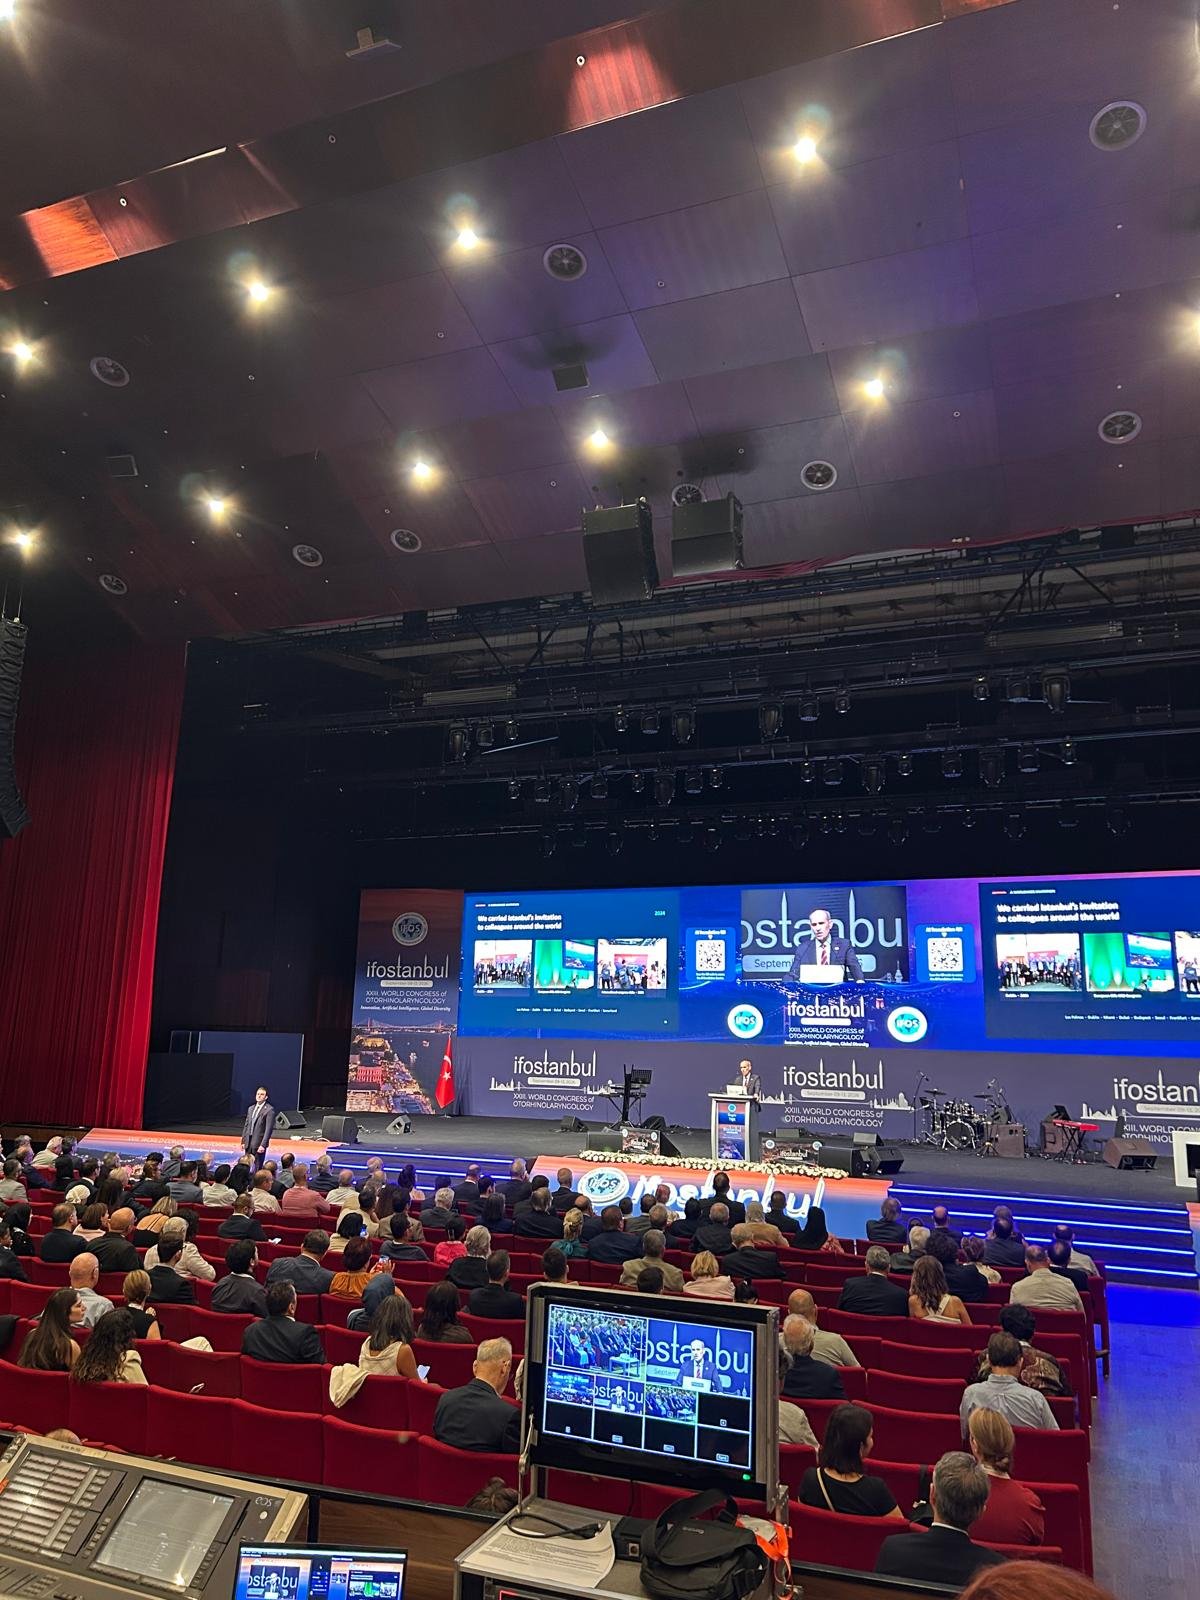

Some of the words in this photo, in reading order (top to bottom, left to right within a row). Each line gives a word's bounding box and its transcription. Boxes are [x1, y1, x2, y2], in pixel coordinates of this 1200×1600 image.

[996, 904, 1011, 912] We
[1012, 903, 1039, 912] carried
[997, 914, 1007, 923] to
[1007, 914, 1049, 923] colleagues
[1050, 913, 1079, 922] around
[1080, 912, 1094, 921] the
[1094, 912, 1120, 921] world
[366, 953, 449, 978] ifostanbul
[754, 958, 795, 970] Septem
[787, 995, 865, 1018] ifostanbul
[513, 1049, 597, 1077] ifostanbul
[783, 1058, 884, 1090] ifostanbul
[1113, 1069, 1200, 1103] ifostan
[552, 1095, 587, 1103] CONGRESS
[513, 1101, 594, 1111] OTORHINOLARYNGOLOGY
[802, 1107, 832, 1116] WORLD
[832, 1109, 875, 1118] CONGRESS
[876, 1110, 884, 1118] of
[784, 1115, 884, 1127] OTORHINOLARYNGOLOGY
[1139, 1125, 1175, 1133] WORLD
